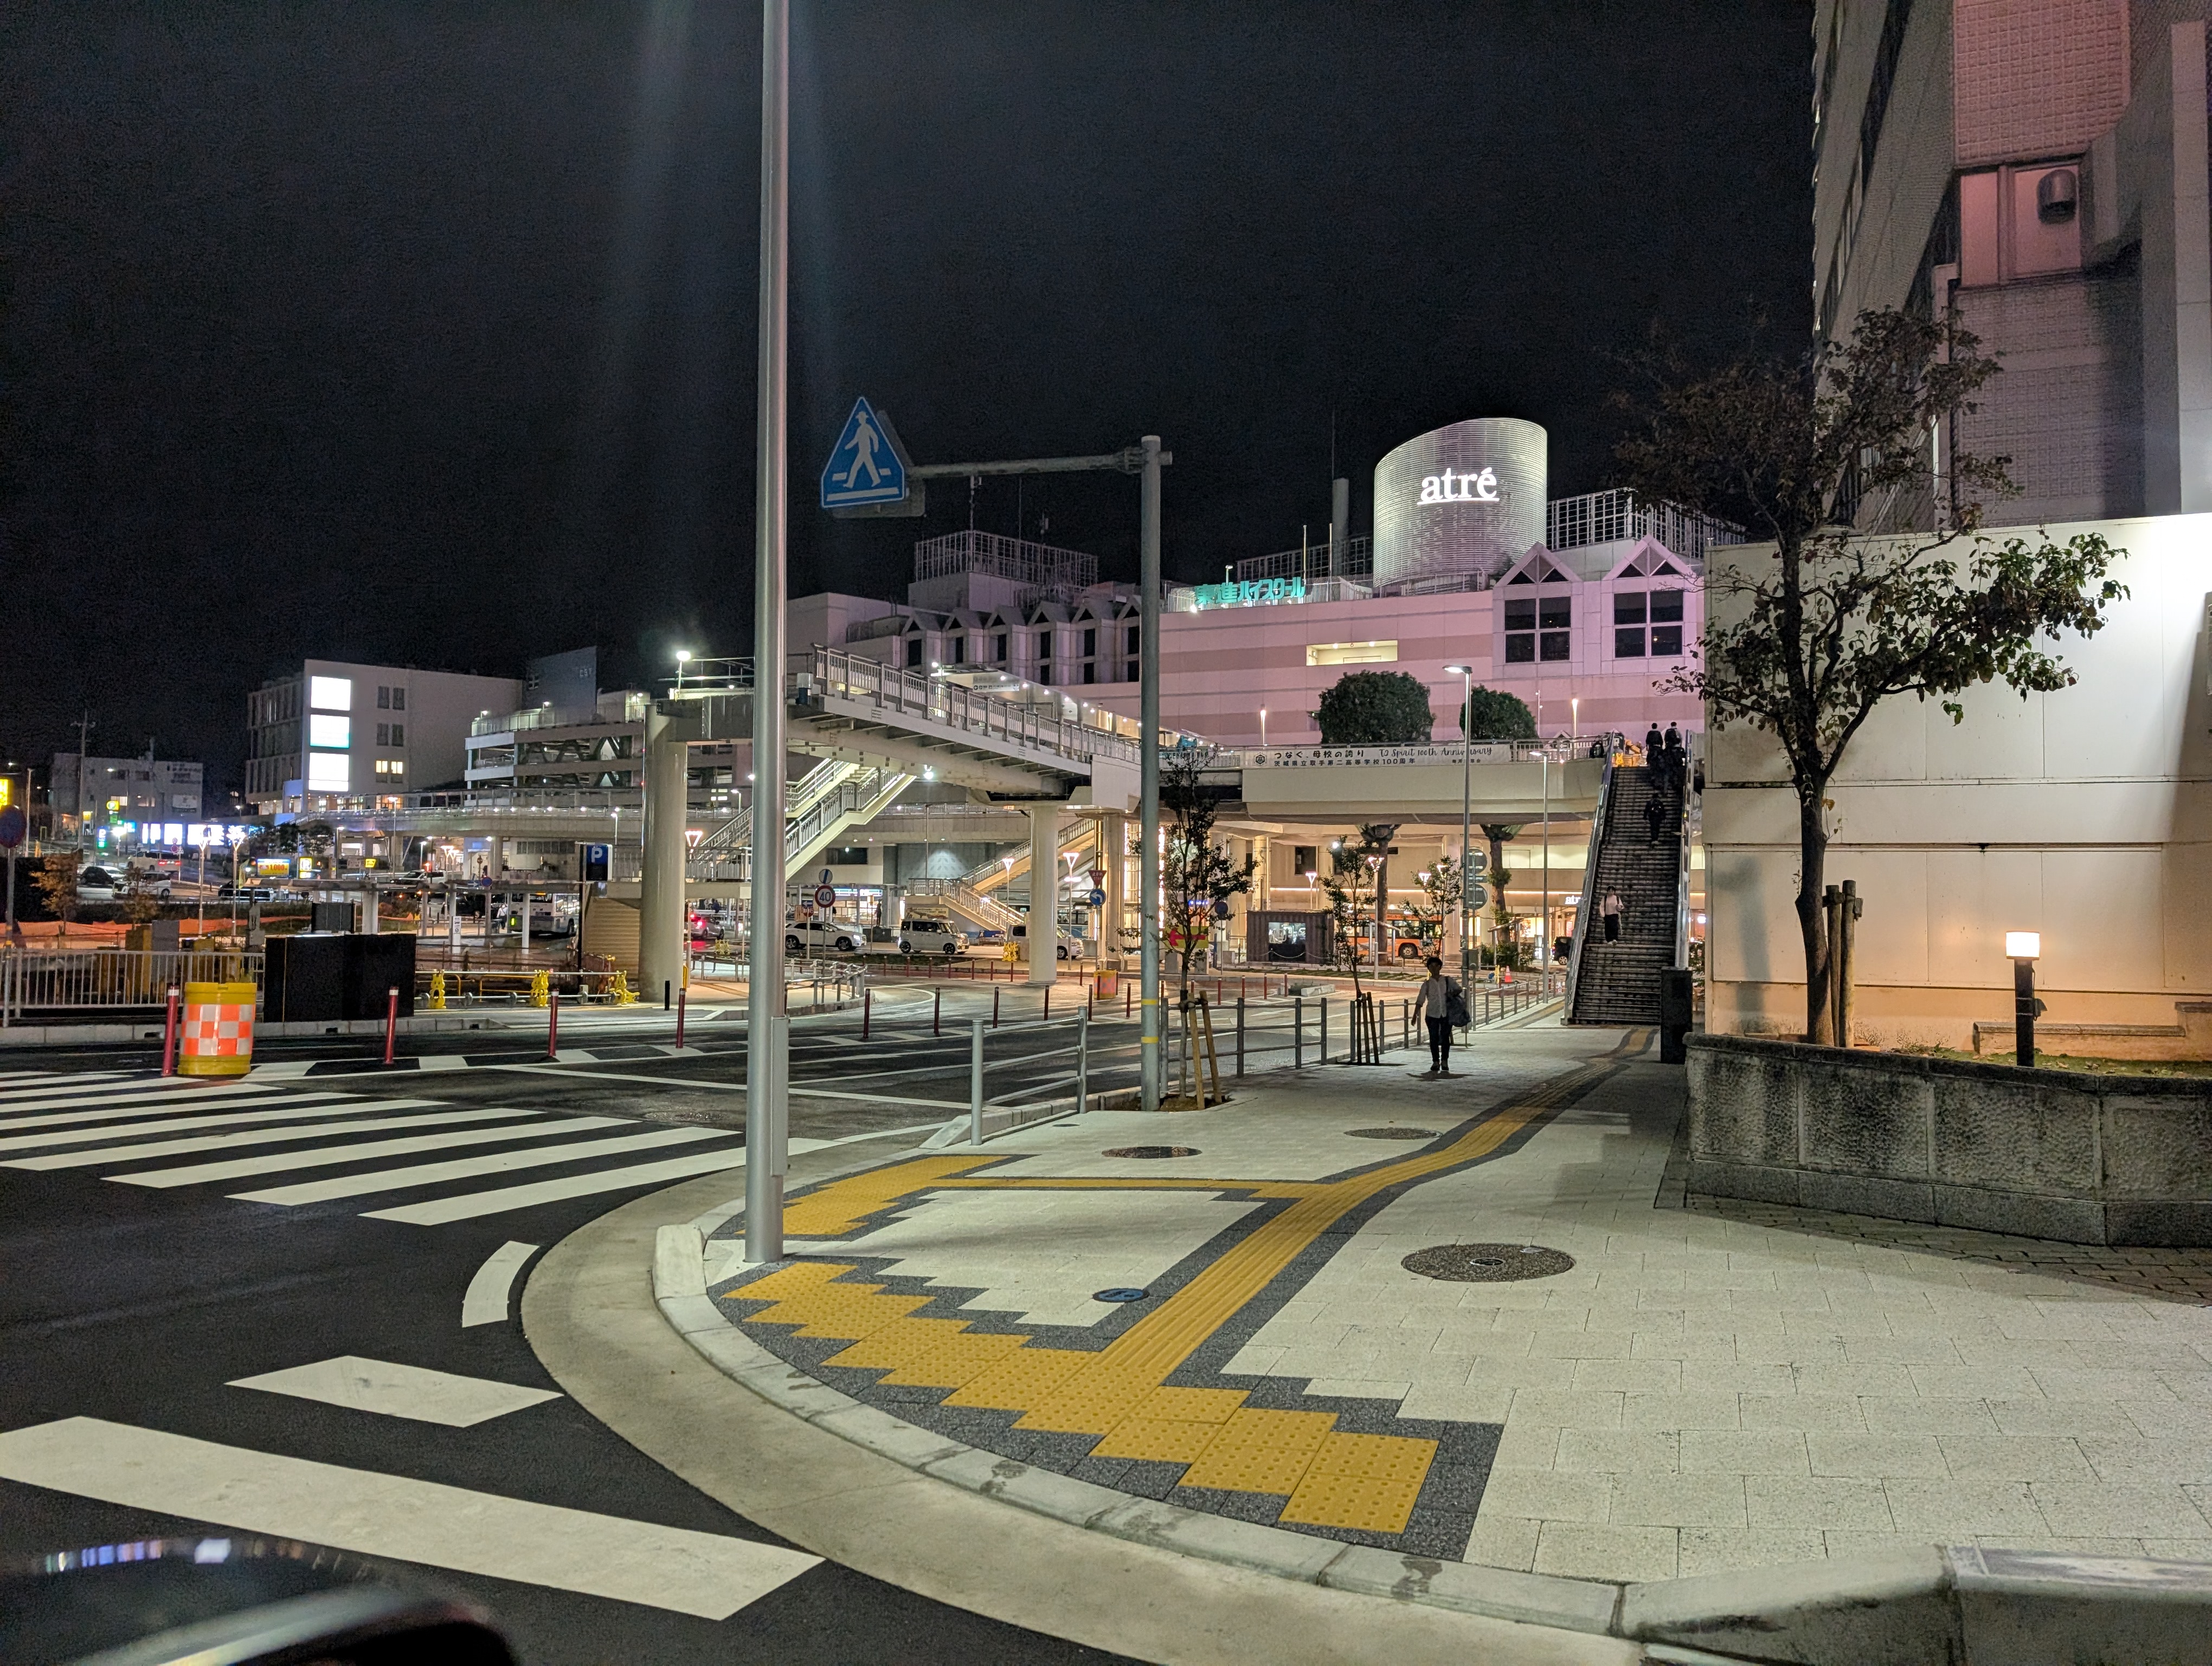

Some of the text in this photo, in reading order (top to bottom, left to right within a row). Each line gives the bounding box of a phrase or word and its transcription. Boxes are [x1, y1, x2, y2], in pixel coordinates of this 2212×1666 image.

[1420, 467, 1497, 502] atré
[1194, 576, 1306, 605] 東進ハイスクール
[1418, 748, 1438, 756] 100th
[1441, 747, 1493, 755] Annivrsary
[1274, 758, 1416, 766] 茨城県立取手第二高等学校100周年
[591, 848, 603, 863] P
[819, 892, 831, 902] 40
[1565, 895, 1581, 905] atr
